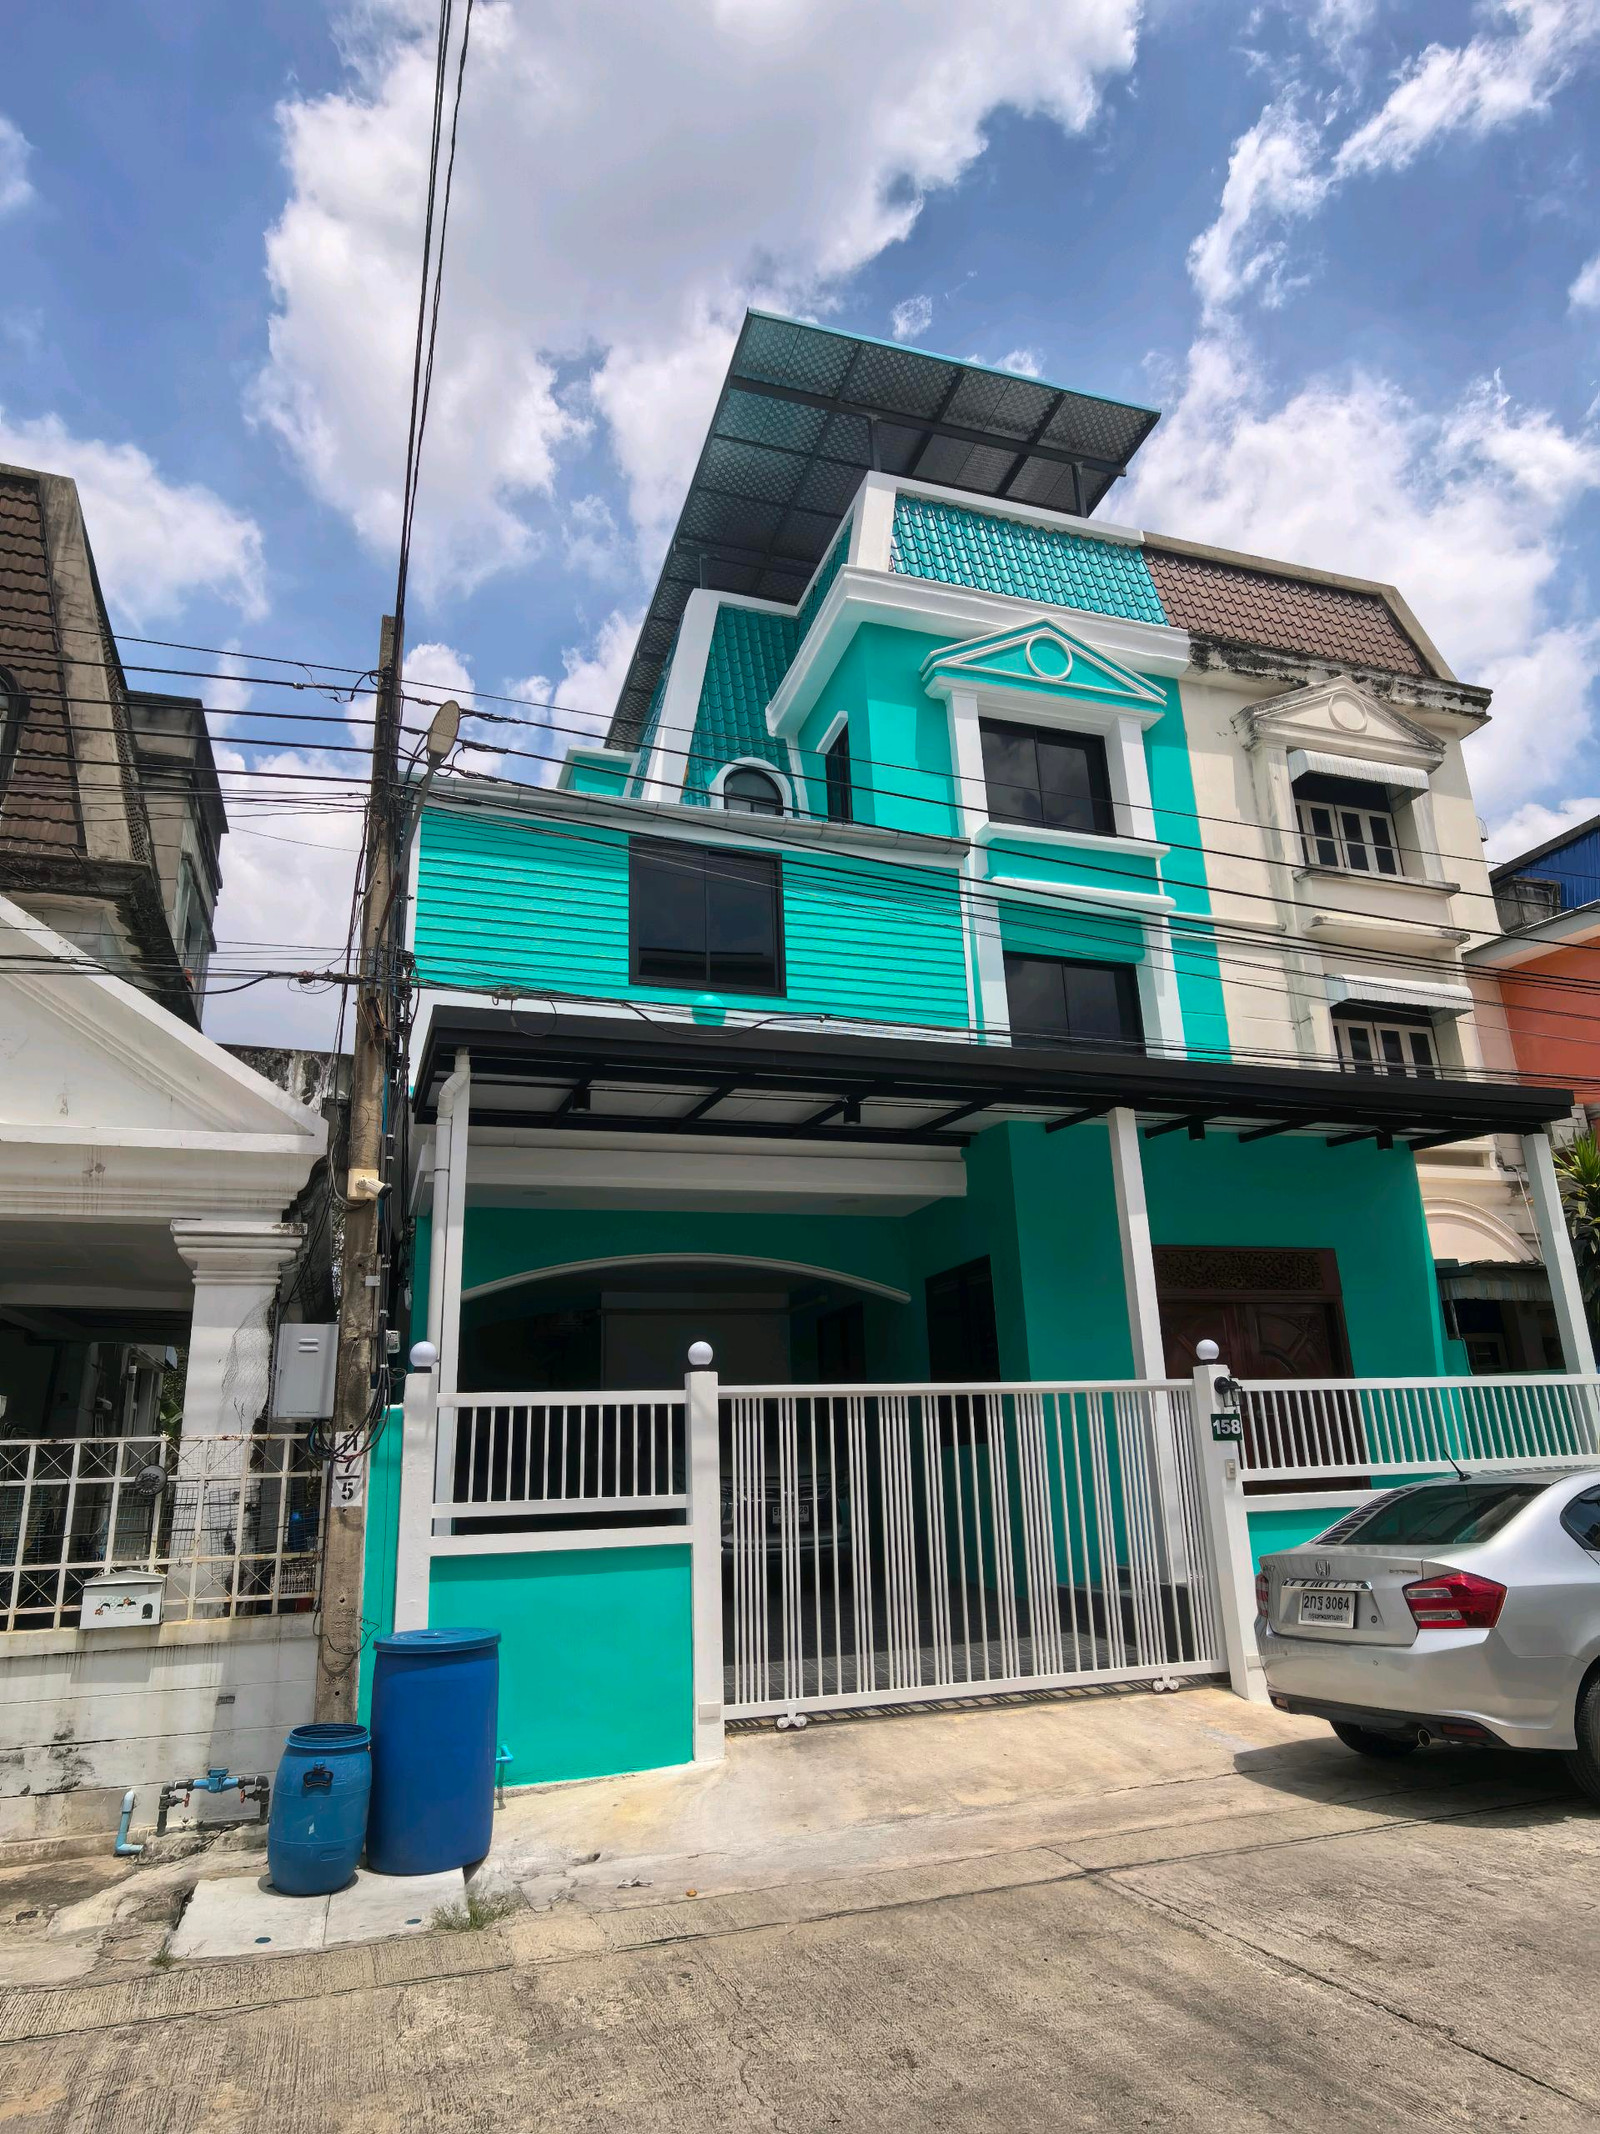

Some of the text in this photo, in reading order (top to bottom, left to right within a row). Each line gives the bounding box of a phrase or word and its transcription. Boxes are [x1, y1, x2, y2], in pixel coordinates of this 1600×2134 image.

[1213, 1419, 1241, 1435] 158
[341, 1482, 354, 1500] 5
[1326, 1596, 1349, 1611] 3064
